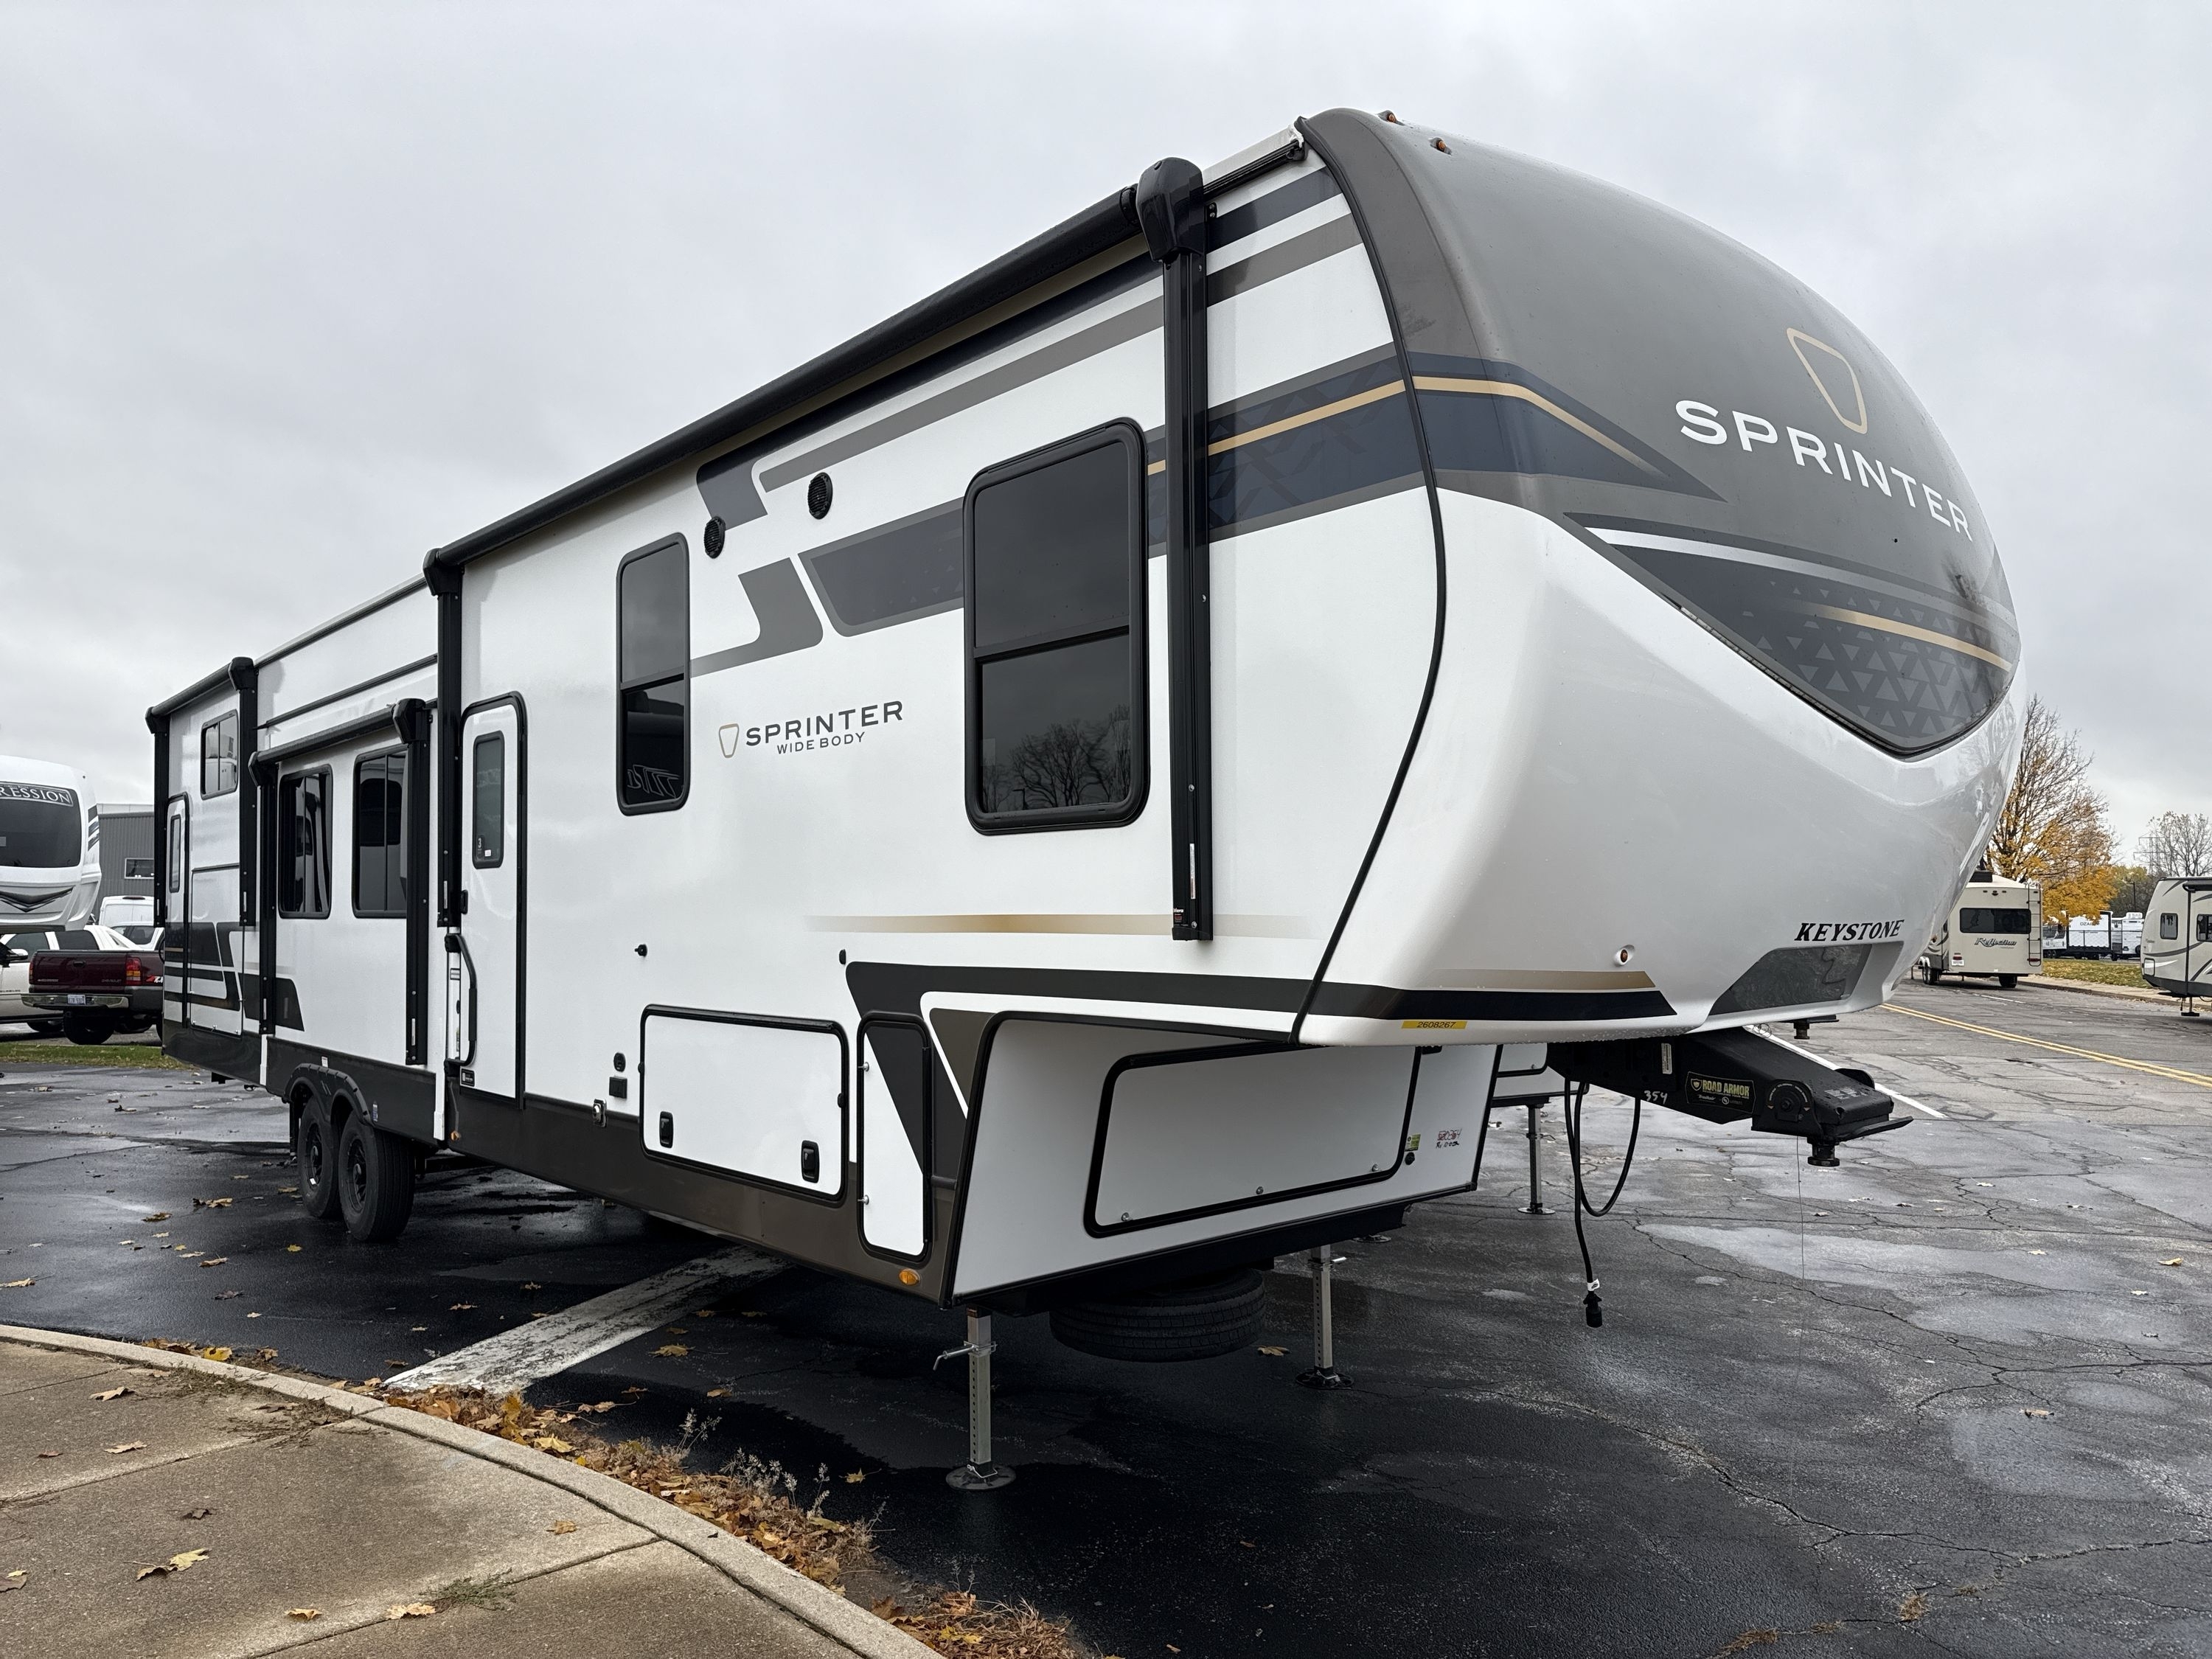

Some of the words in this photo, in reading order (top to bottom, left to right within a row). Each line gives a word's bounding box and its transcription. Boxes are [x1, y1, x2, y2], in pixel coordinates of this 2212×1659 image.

[1675, 400, 1972, 543] SPRINTER
[745, 700, 903, 746] SPRINTER
[777, 740, 815, 754] WIDE
[819, 731, 866, 748] BODY
[1794, 919, 1905, 942] KEYSTONE
[1974, 937, 2017, 947] Reflection
[1644, 1090, 1668, 1105] 354
[1702, 1079, 1722, 1093] ROAD
[1722, 1082, 1750, 1097] ARMOR
